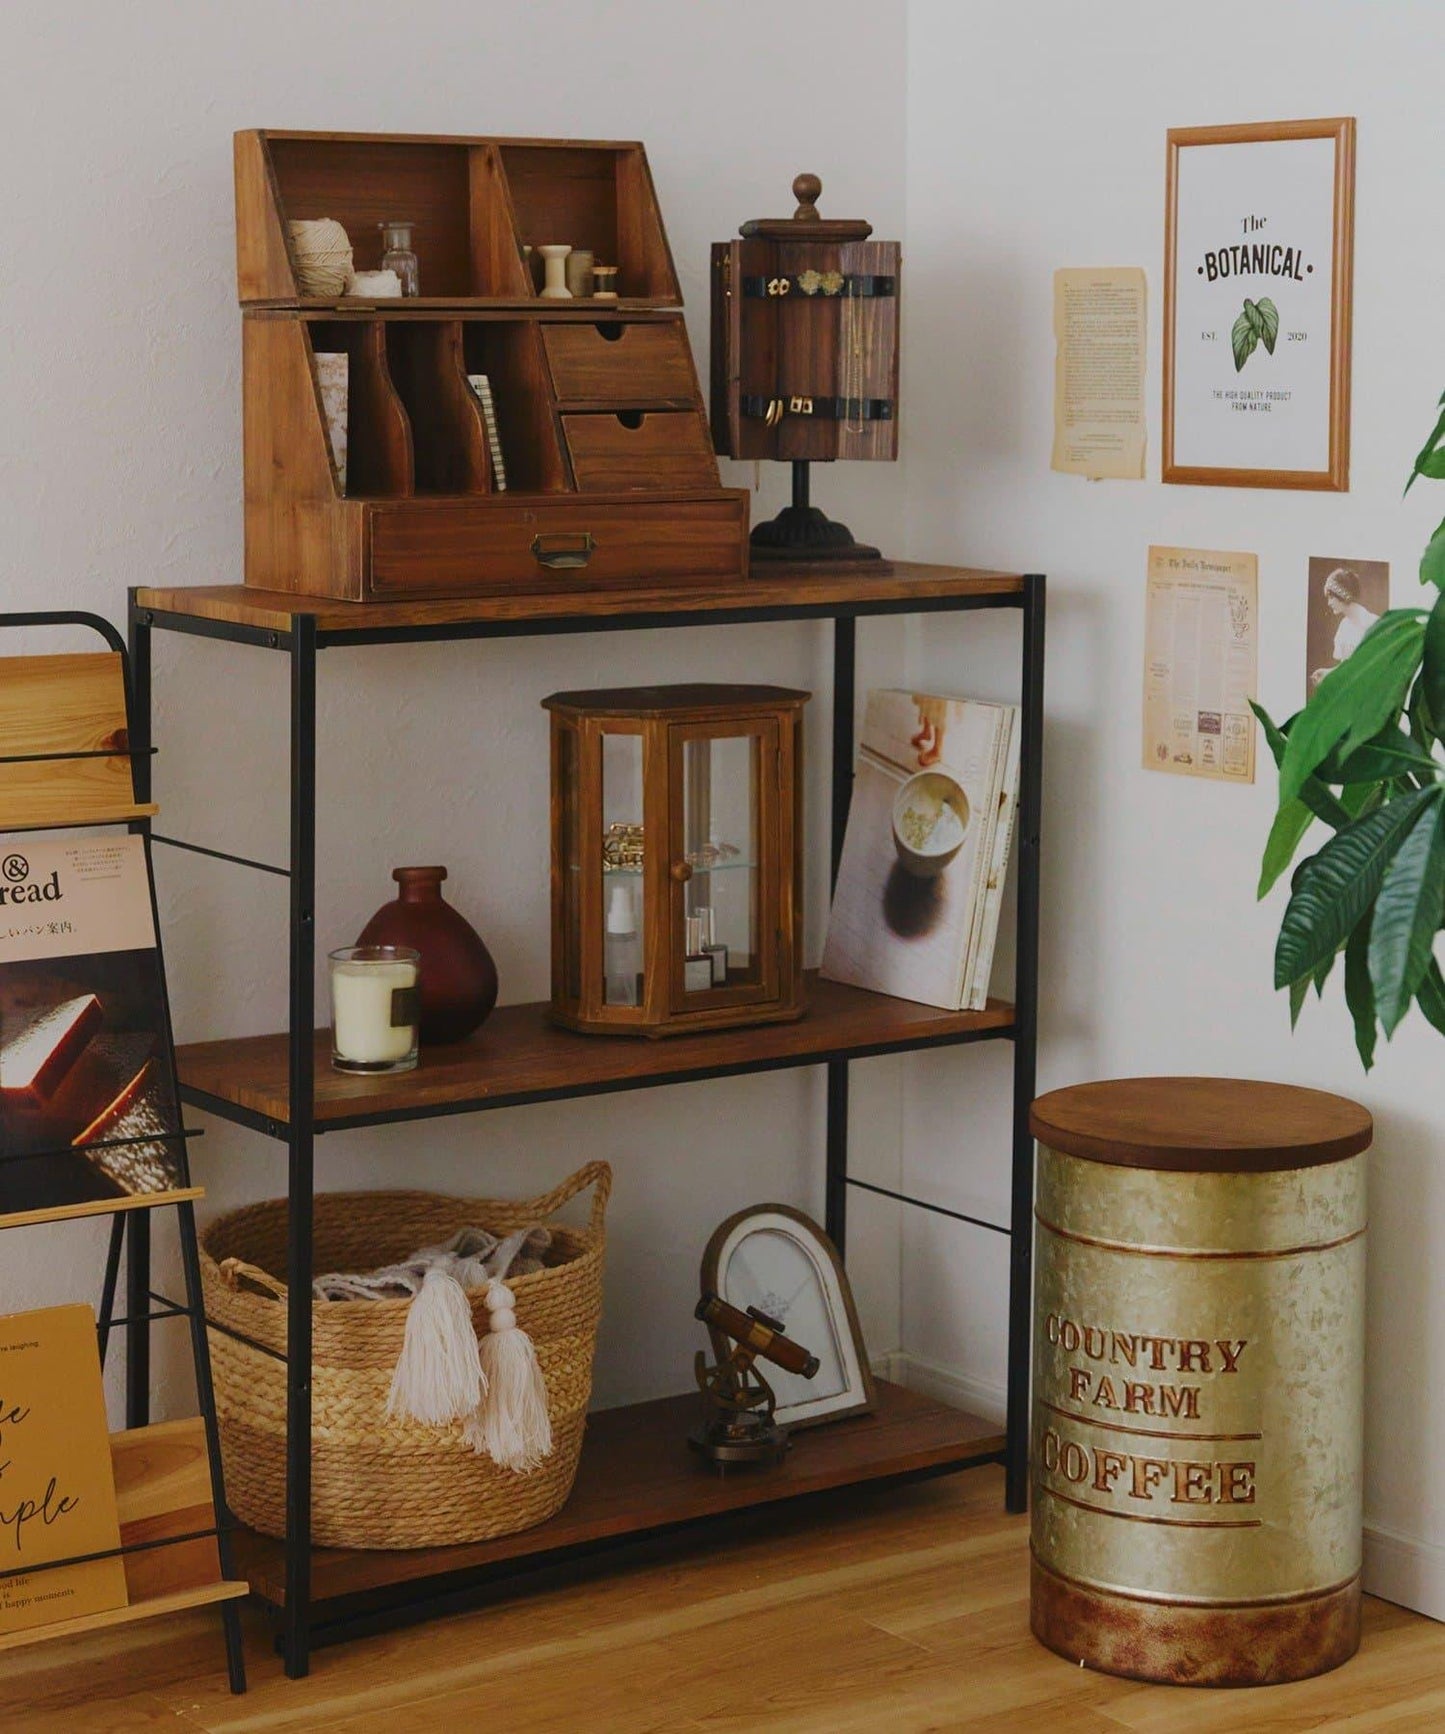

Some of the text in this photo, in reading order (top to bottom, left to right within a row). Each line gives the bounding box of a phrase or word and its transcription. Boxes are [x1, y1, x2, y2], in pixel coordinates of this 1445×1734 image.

[1241, 215, 1267, 233] The
[1205, 244, 1303, 282] BOTANICAL
[1287, 332, 1307, 341] 2020
[1213, 390, 1291, 401] THE HIGH QUALITY PRODUCT
[1231, 402, 1272, 412] FROM NATURE
[1045, 1314, 1248, 1373] COUNTRY
[1069, 1366, 1202, 1419] FARM
[1043, 1430, 1256, 1504] COFFEE
